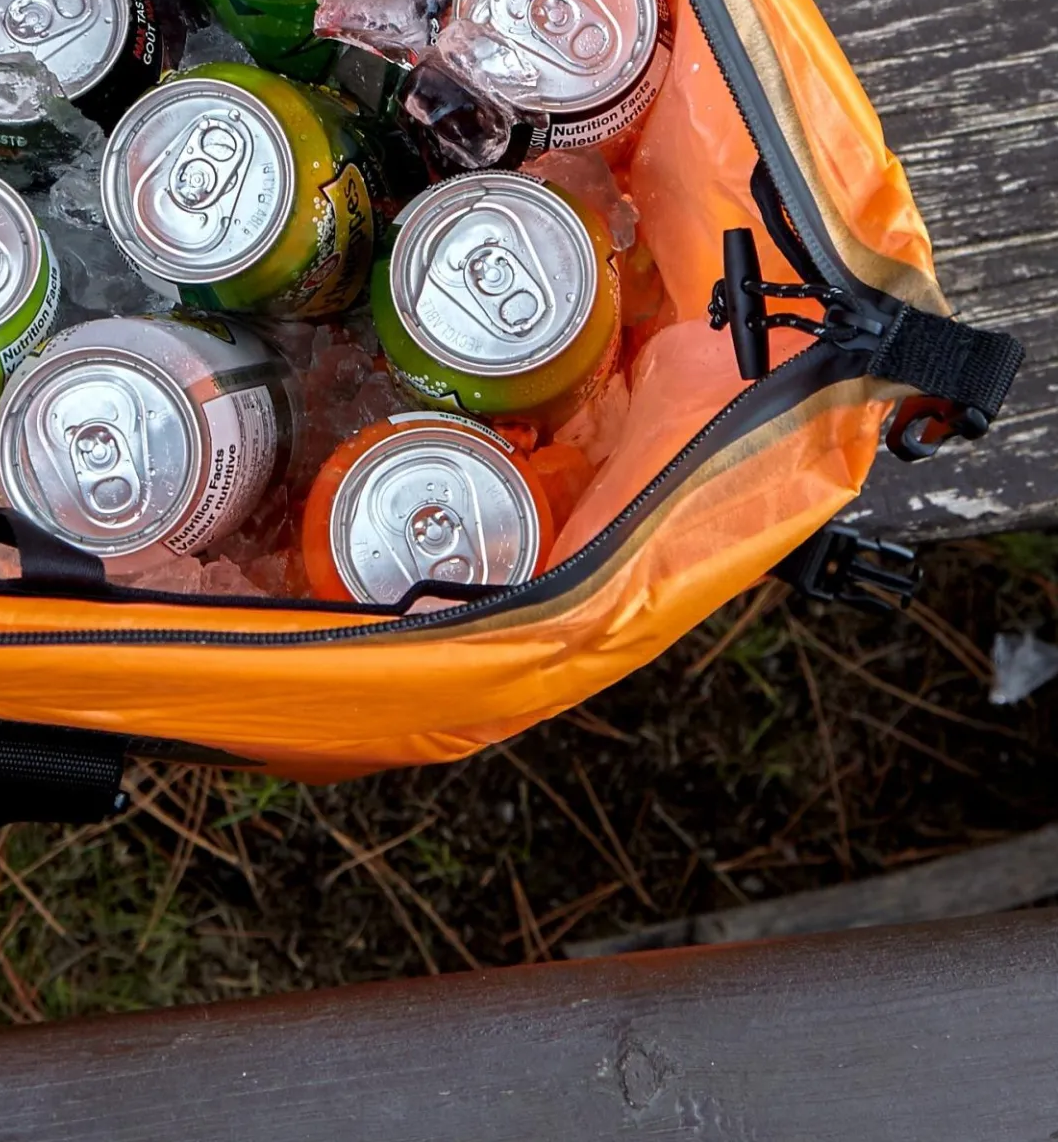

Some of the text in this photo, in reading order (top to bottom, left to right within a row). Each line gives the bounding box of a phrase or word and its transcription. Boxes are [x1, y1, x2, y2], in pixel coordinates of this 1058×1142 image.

[143, 23, 156, 65] GOÛT
[552, 132, 603, 148] Valeur
[607, 87, 657, 136] nutritive
[554, 80, 651, 136] Nutrition Facts
[2, 308, 50, 363] Nutrition
[46, 266, 59, 309] Facts
[470, 421, 511, 450] Nutrition
[168, 448, 225, 547] Nutrition Facts
[177, 513, 216, 554] Valeur
[215, 443, 237, 511] nutritive
